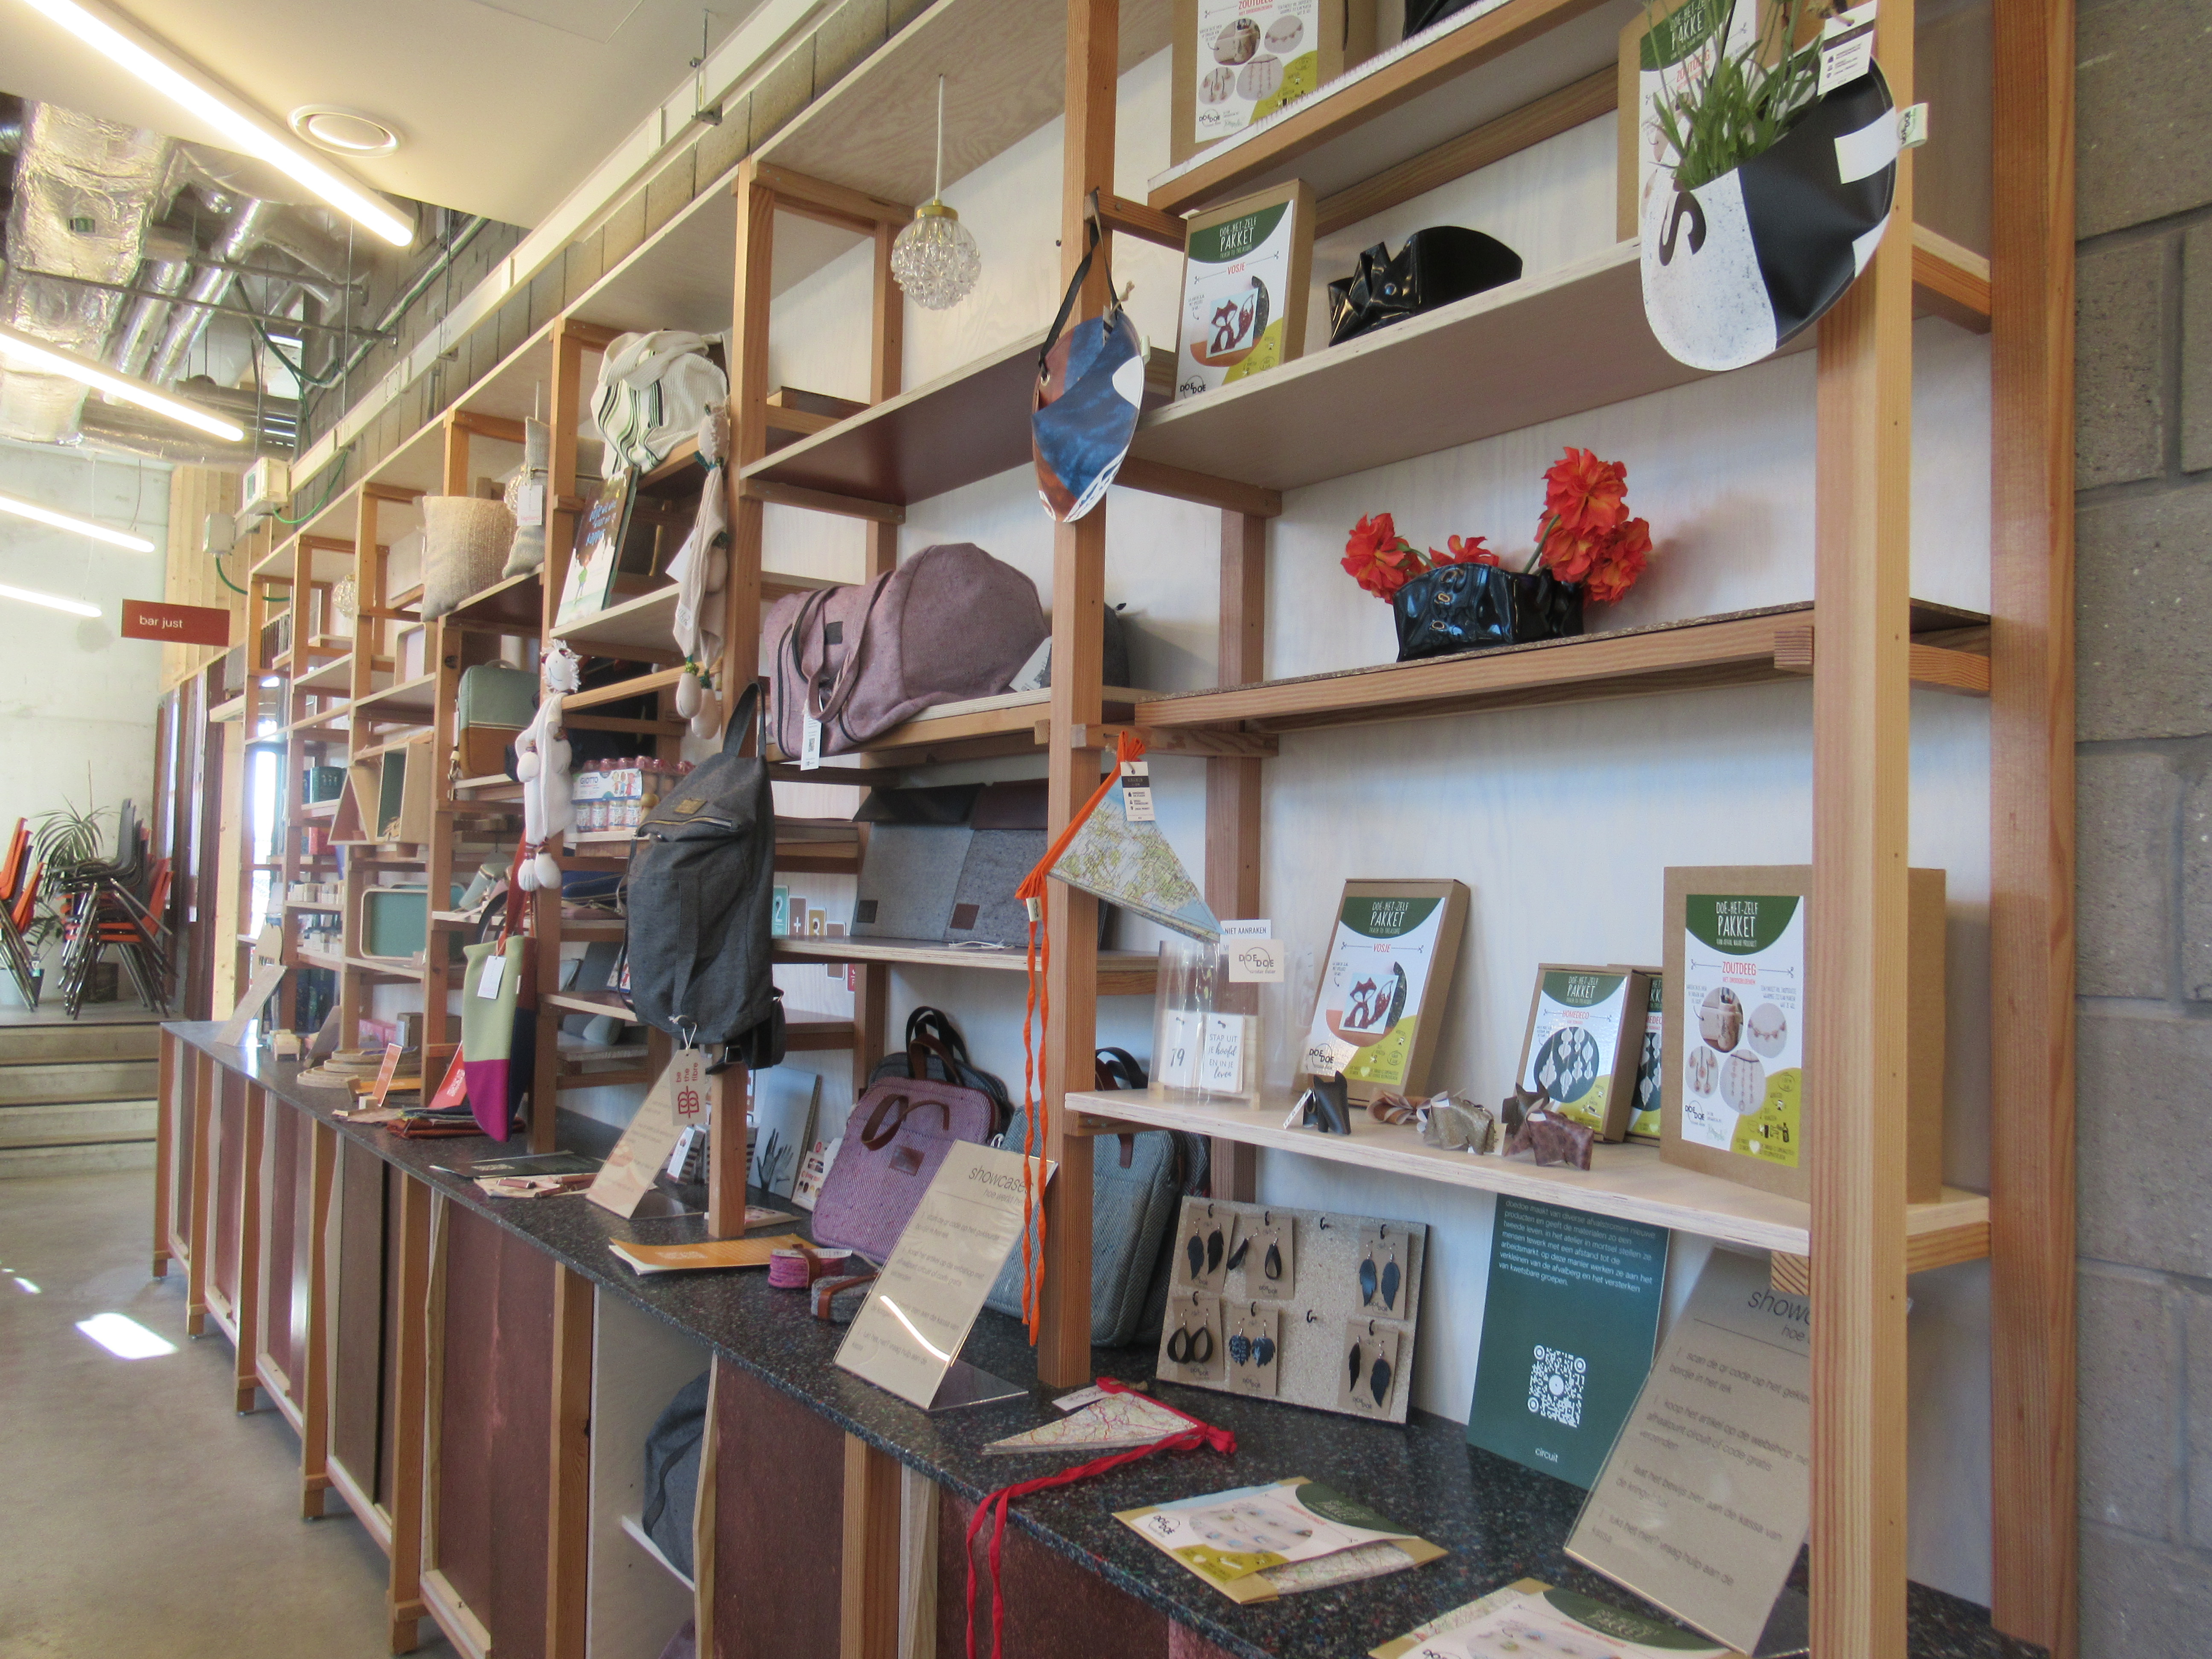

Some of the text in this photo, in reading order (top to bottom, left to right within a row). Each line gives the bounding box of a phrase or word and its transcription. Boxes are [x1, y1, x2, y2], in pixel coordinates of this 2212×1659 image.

[1220, 216, 1257, 237] DOE-HET-ZELF
[1220, 227, 1254, 252] PAKKET
[1228, 262, 1245, 275] VOSJE
[1180, 383, 1206, 394] DOE DOE
[139, 615, 183, 629] bar just
[1372, 901, 1409, 911] DOE-HET-ZELF
[1716, 901, 1758, 915] DOE-HET-ZELF
[1370, 911, 1405, 927] PAKKET
[1718, 915, 1755, 937] PAKKET
[1373, 943, 1391, 953] VOSJE
[1723, 961, 1756, 975] ZOUTDEEG
[1568, 976, 1599, 986] DOE-HET-ZELF
[1567, 984, 1595, 998] PAKKET
[1562, 1010, 1589, 1019] HOMEDECO
[1216, 1042, 1237, 1058] hoofd
[1320, 1055, 1334, 1064] DOE
[676, 1072, 681, 1083] be
[1214, 1066, 1232, 1079] leven
[1694, 1112, 1705, 1121] DOE
[969, 1165, 1033, 1194] showcase
[1506, 1200, 1529, 1210] doedoe
[1530, 1206, 1548, 1215] maakt
[1505, 1211, 1535, 1222] producten
[1545, 1220, 1562, 1229] geeft
[1504, 1220, 1525, 1231] tweede
[1552, 1231, 1563, 1240] het
[1502, 1231, 1620, 1265] mensen tewerk met een afstand tot de
[1499, 1262, 1509, 1270] van
[1510, 1263, 1540, 1278] kwetsbare
[1500, 1252, 1529, 1264] verkleinen
[1543, 1262, 1550, 1270] de
[1552, 1265, 1580, 1279] afvalberg
[1592, 1274, 1603, 1283] het
[1605, 1278, 1640, 1293] versterken
[1541, 1251, 1550, 1259] op
[1551, 1253, 1566, 1263] deze
[1568, 1258, 1589, 1268] manier
[1591, 1263, 1614, 1275] werken
[1640, 1274, 1652, 1284] het
[1781, 1324, 1805, 1342] hoe
[1535, 1447, 1558, 1463] circuit
